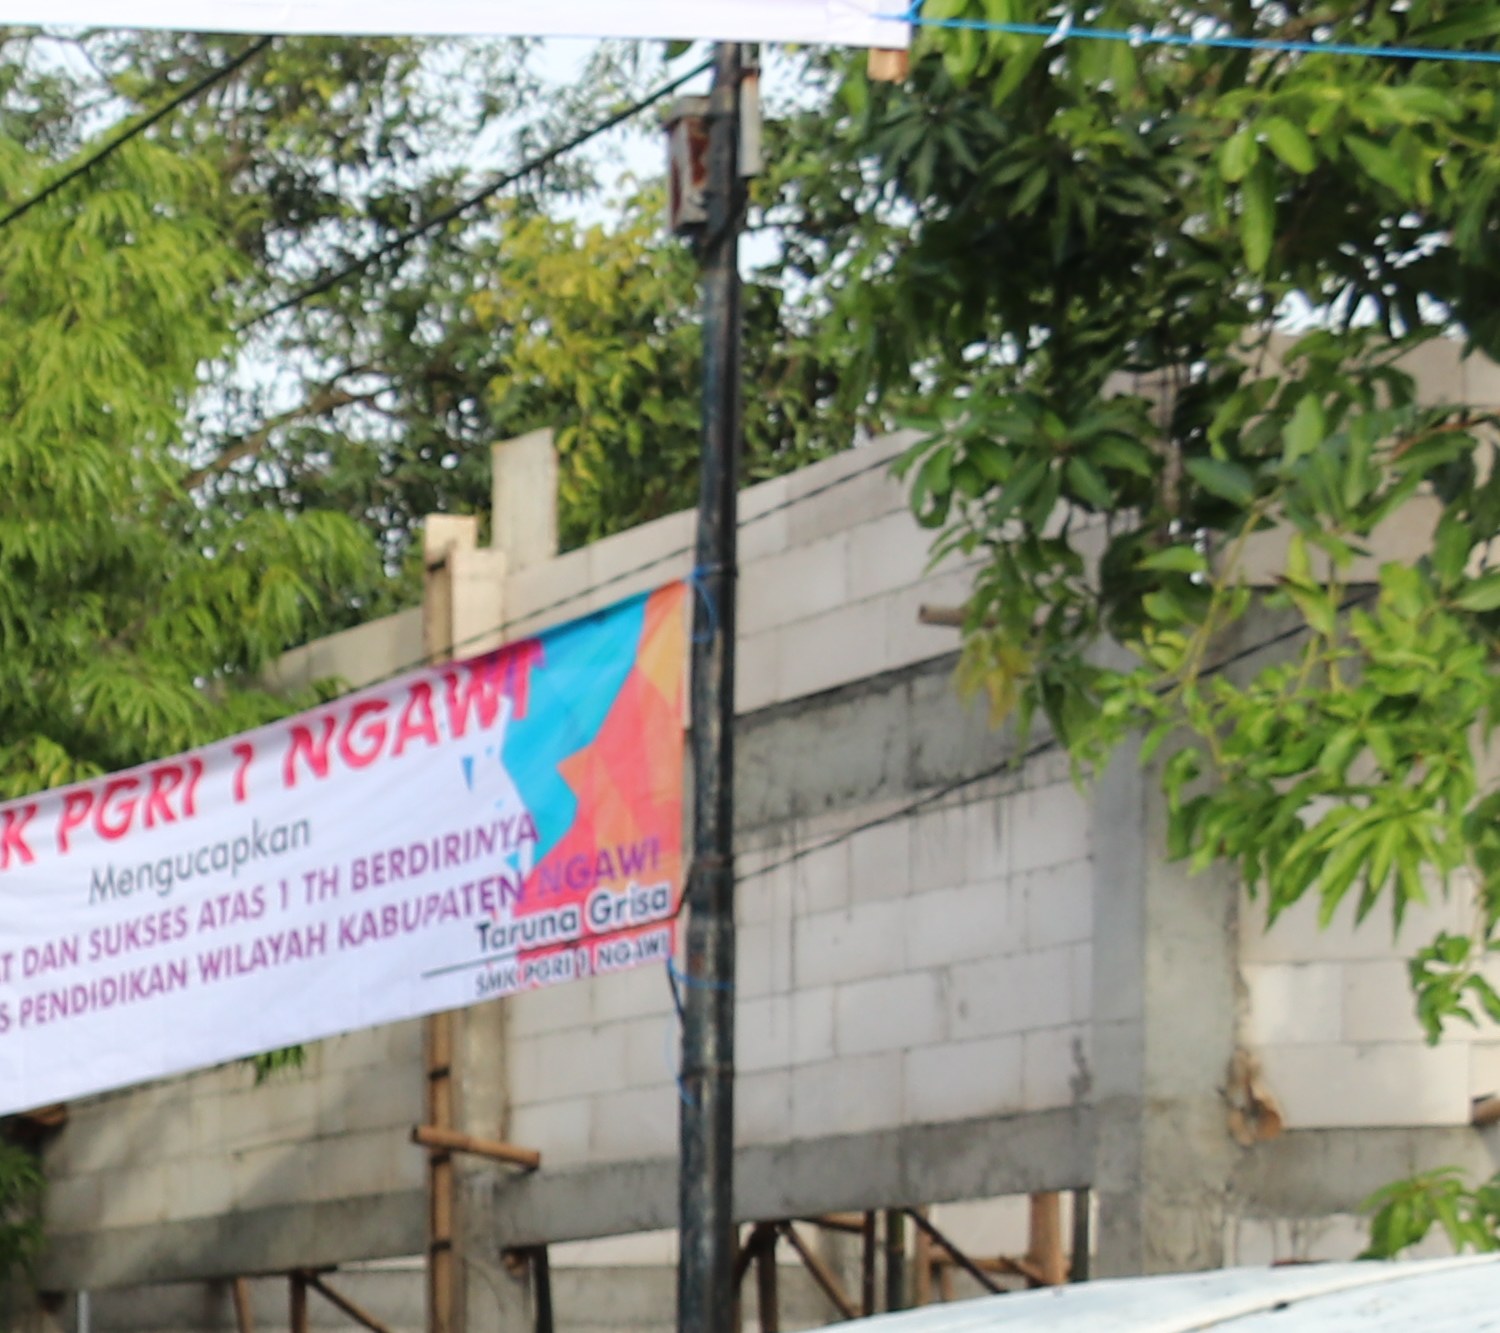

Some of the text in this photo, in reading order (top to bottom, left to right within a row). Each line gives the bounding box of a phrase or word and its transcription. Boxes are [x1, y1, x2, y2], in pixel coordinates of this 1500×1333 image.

[55, 757, 204, 855] PGRI
[230, 741, 256, 803] 1
[281, 638, 546, 788] NGAWI
[21, 936, 80, 978] DAN
[87, 905, 189, 963] SUKSES
[196, 885, 266, 935] ATAS
[278, 879, 289, 912] 1
[302, 865, 340, 905] TH
[350, 812, 541, 893] BERDIRINYA
[88, 816, 311, 906] Mengucapkan
[476, 884, 671, 953] Taruna Grisa
[18, 960, 189, 1029] PENDIDIKAN
[195, 922, 328, 984] WILAYAH
[337, 871, 526, 951] KABUPATEN
[536, 836, 662, 898] NGAWI
[475, 967, 518, 997] SMK
[523, 955, 573, 985] PGRI
[597, 931, 670, 970] NGAWI
